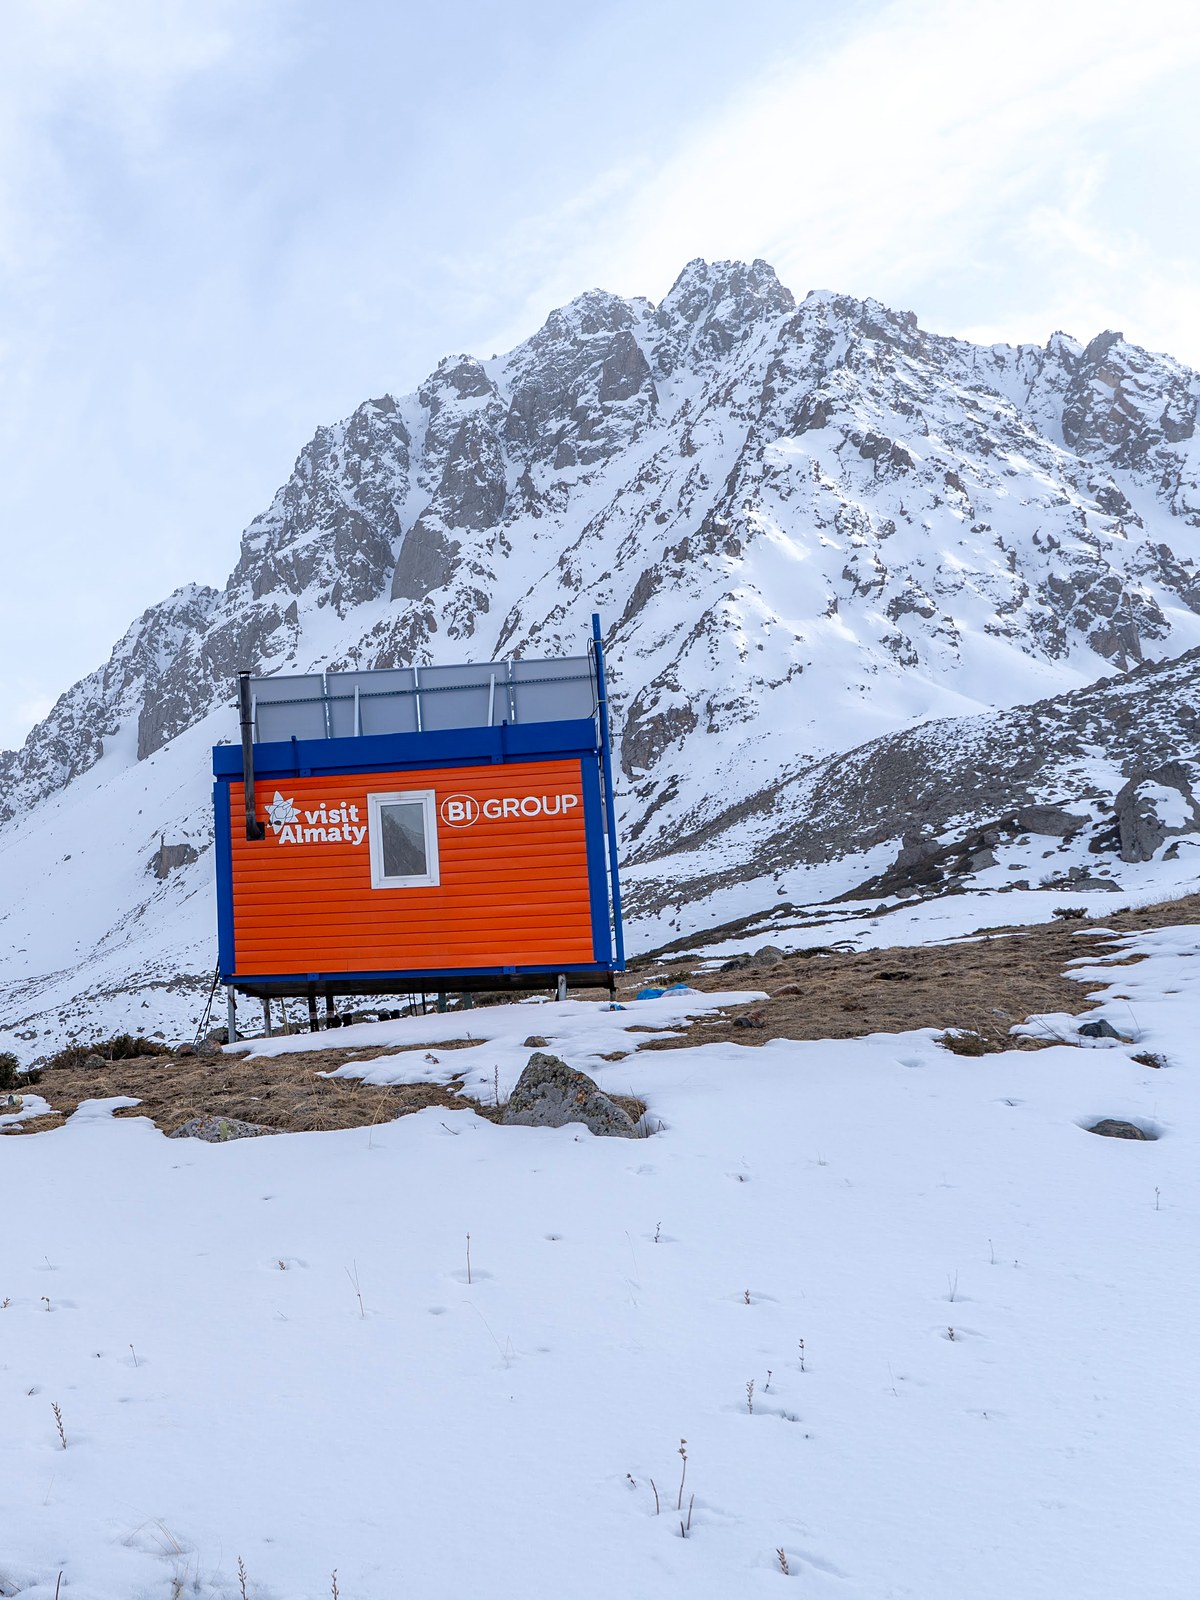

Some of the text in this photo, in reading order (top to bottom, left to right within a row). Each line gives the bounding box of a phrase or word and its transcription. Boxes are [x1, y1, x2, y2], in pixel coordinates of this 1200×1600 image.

[304, 801, 359, 825] visit
[447, 794, 578, 821] BI GROUP
[278, 823, 367, 846] Almaty
